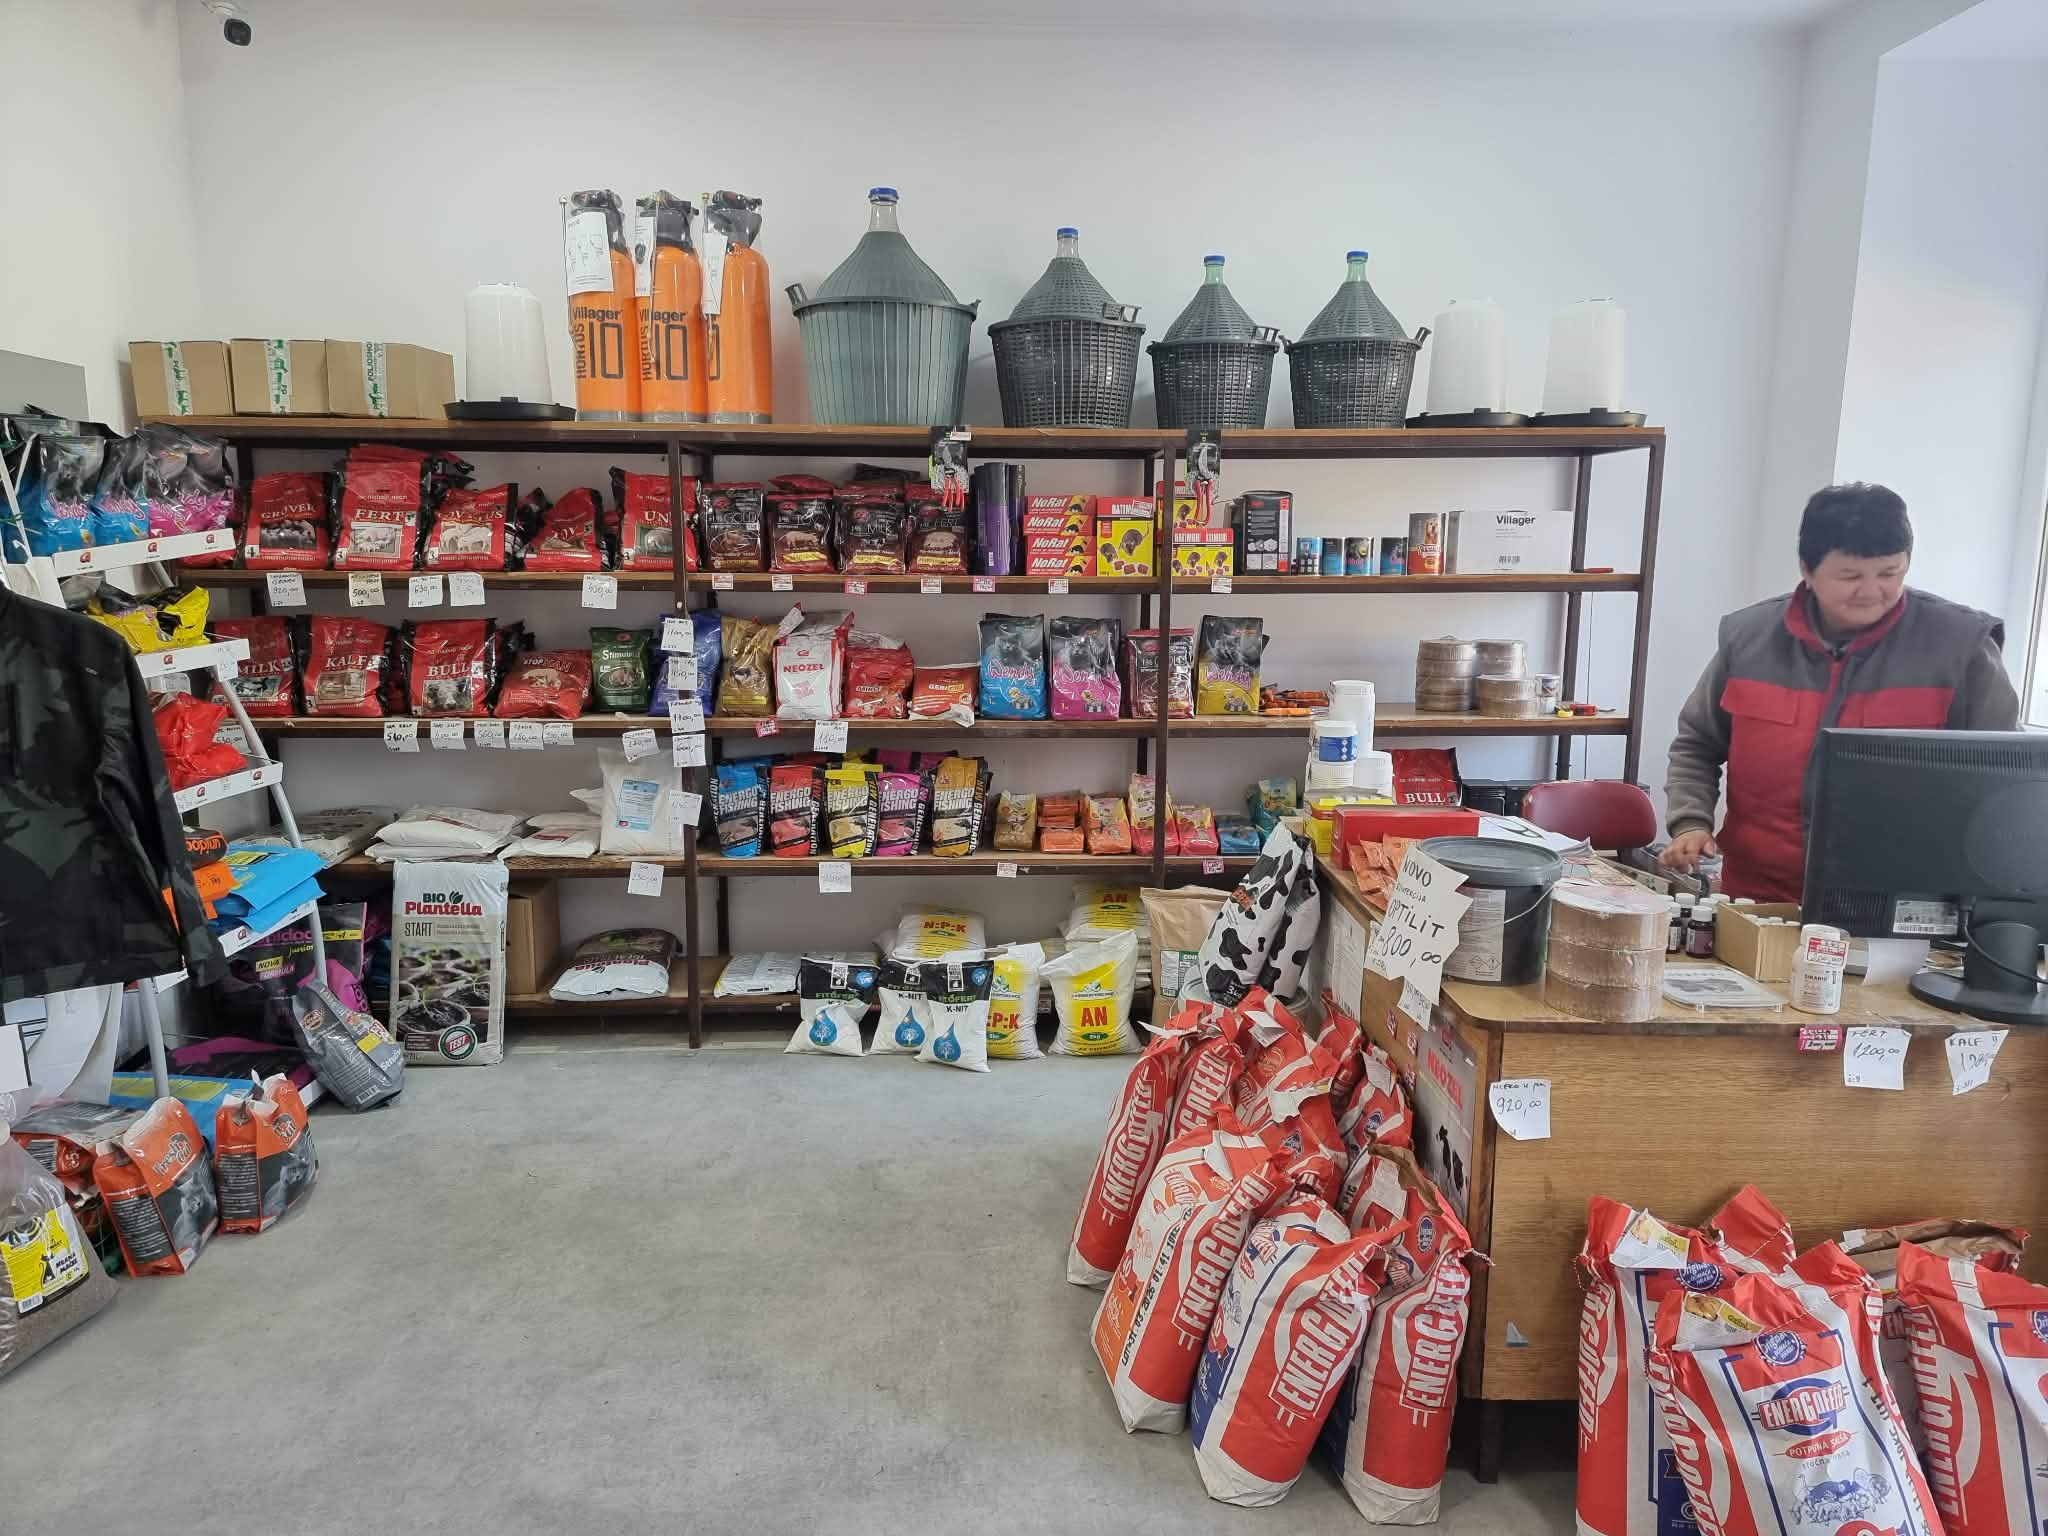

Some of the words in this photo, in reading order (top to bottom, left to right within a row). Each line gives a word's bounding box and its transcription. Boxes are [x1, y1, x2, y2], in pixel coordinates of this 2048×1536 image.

[573, 309, 622, 321] Villager
[639, 310, 688, 322] Villager
[573, 323, 587, 379] HORTUS
[589, 322, 624, 379] 10
[654, 323, 689, 380] 10
[1031, 498, 1068, 508] NoRat
[354, 508, 403, 521] FERT
[1496, 515, 1536, 527] Villager
[1027, 517, 1064, 527] NoRat
[1032, 538, 1069, 548] NoRat
[1031, 558, 1069, 568] NoRat
[325, 656, 368, 668] KALF
[783, 663, 825, 673] NEOZEL
[427, 663, 471, 677] BULL
[720, 785, 759, 803] ENERGO
[770, 786, 812, 802] ENERGO
[828, 786, 869, 803] ENERGO
[934, 788, 975, 800] ENERGO
[1404, 792, 1446, 804] BULL
[720, 797, 759, 816] FISHING
[770, 797, 811, 815] FISHING
[828, 797, 868, 815] FISHING
[933, 799, 973, 812] FISHING
[864, 800, 878, 855] GENERATION
[1403, 856, 1432, 887] NOVO
[422, 892, 446, 904] BIO
[1102, 893, 1129, 904] AN
[404, 901, 483, 916] Plantella
[404, 922, 433, 937] START
[921, 919, 968, 933] N:P:K
[258, 960, 280, 970] NOVA
[985, 1012, 1020, 1030] :P:K
[1080, 1006, 1109, 1028] AN
[448, 1035, 467, 1049] TEST
[1949, 1037, 1985, 1048] KALF
[1852, 1042, 1902, 1061] 1200,00
[1497, 1097, 1543, 1120] 920,00
[1762, 1380, 1846, 1429] ENERGOFEED
